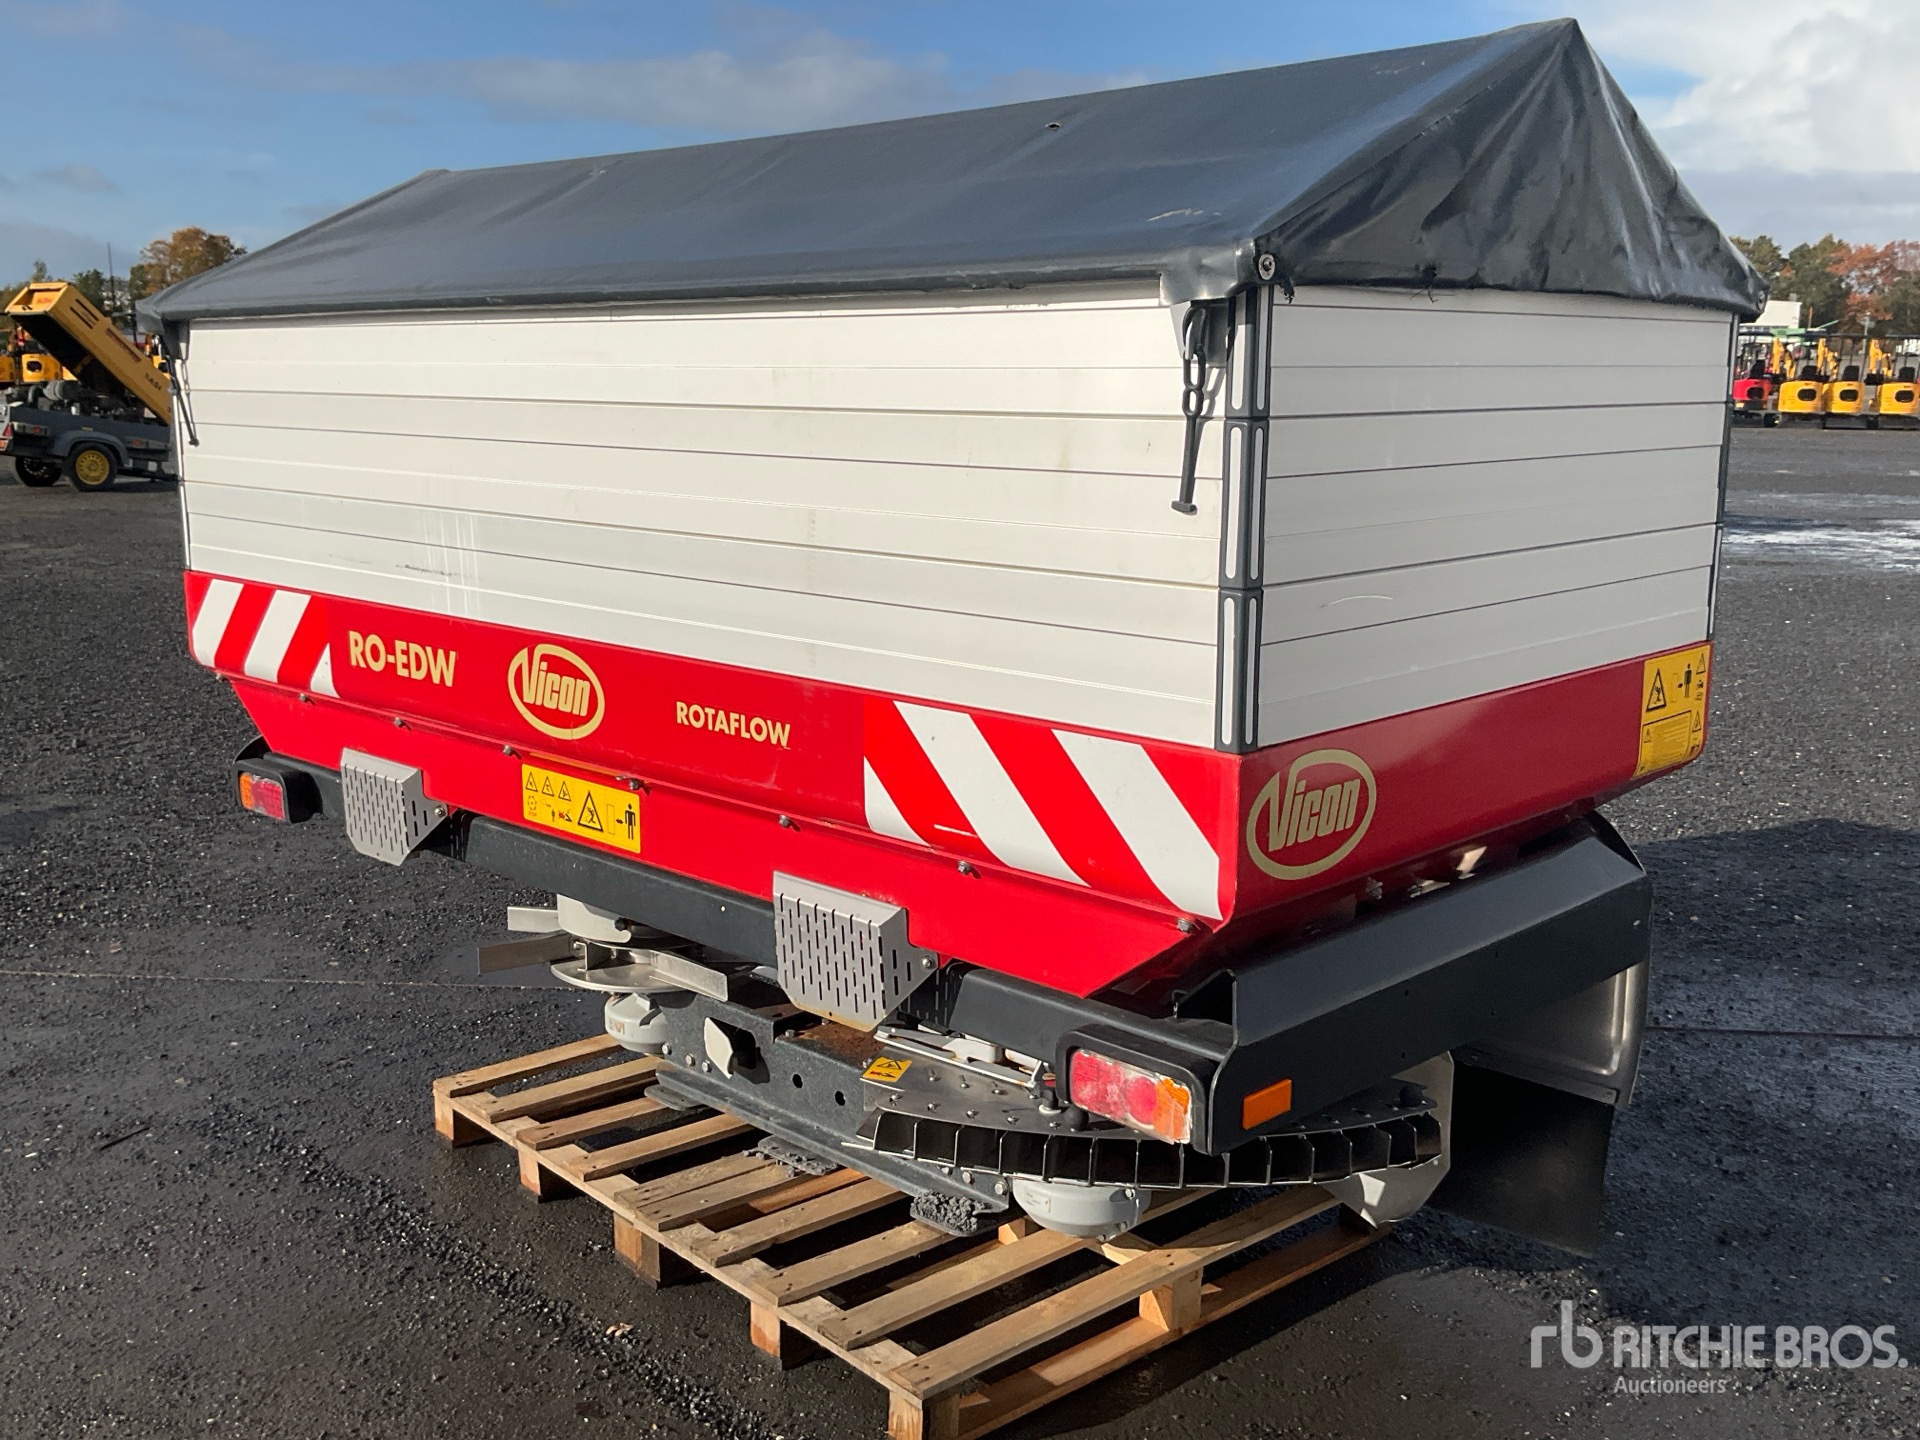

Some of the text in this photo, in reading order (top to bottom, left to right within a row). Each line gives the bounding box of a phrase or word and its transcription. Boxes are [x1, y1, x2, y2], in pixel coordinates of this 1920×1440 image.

[348, 630, 457, 687] RO-EDW
[521, 646, 591, 718] Vicon
[675, 700, 791, 747] ROTAFLOW
[1267, 756, 1361, 853] Vicon
